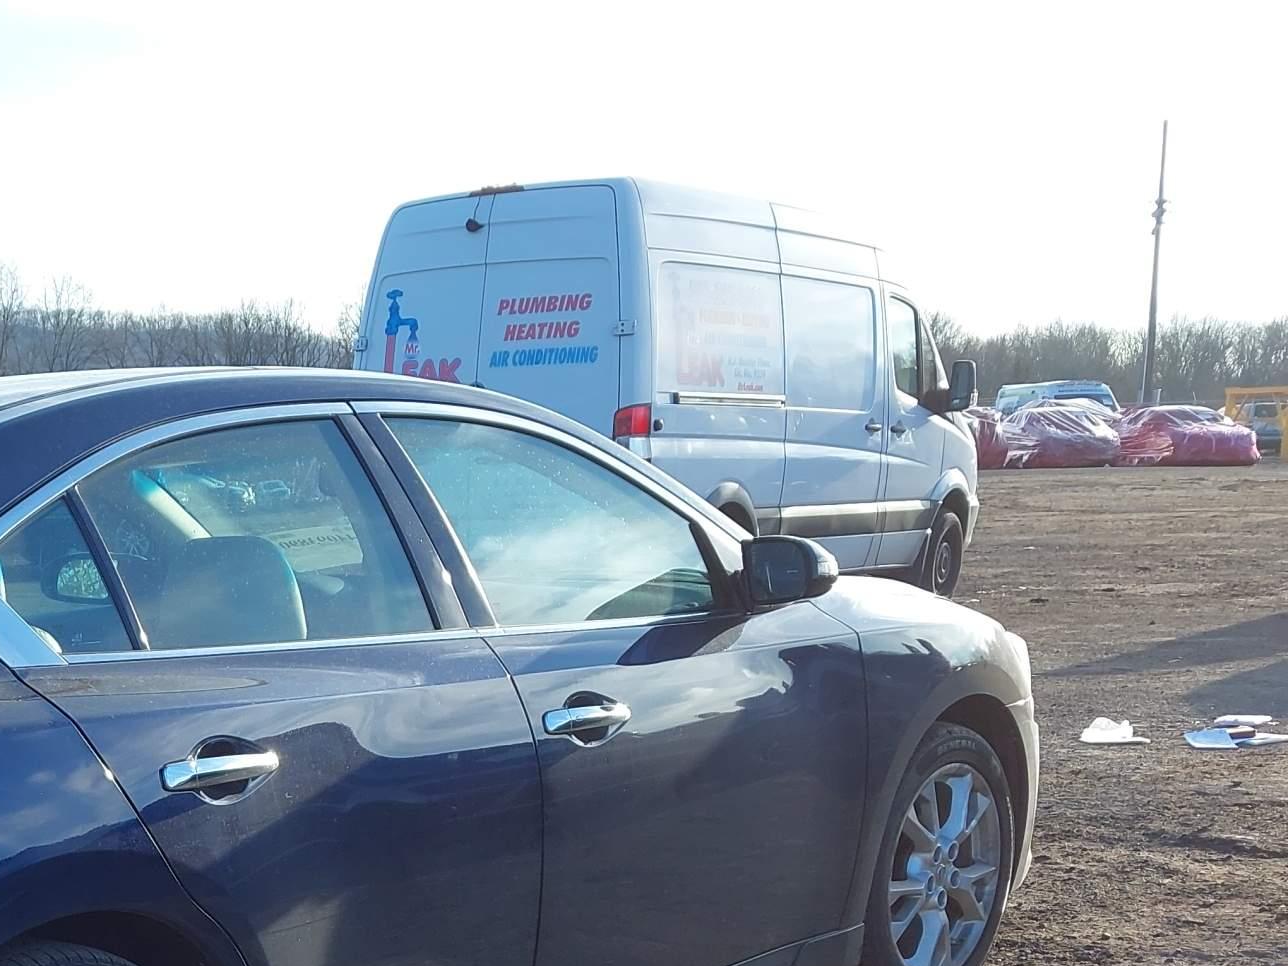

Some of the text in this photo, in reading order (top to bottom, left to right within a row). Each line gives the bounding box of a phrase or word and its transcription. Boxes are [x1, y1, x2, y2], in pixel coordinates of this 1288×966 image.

[497, 293, 592, 315] PLUMBING
[503, 321, 580, 341] HEATING
[405, 343, 420, 354] Mr.
[489, 345, 599, 368] AIR CONDITIONING
